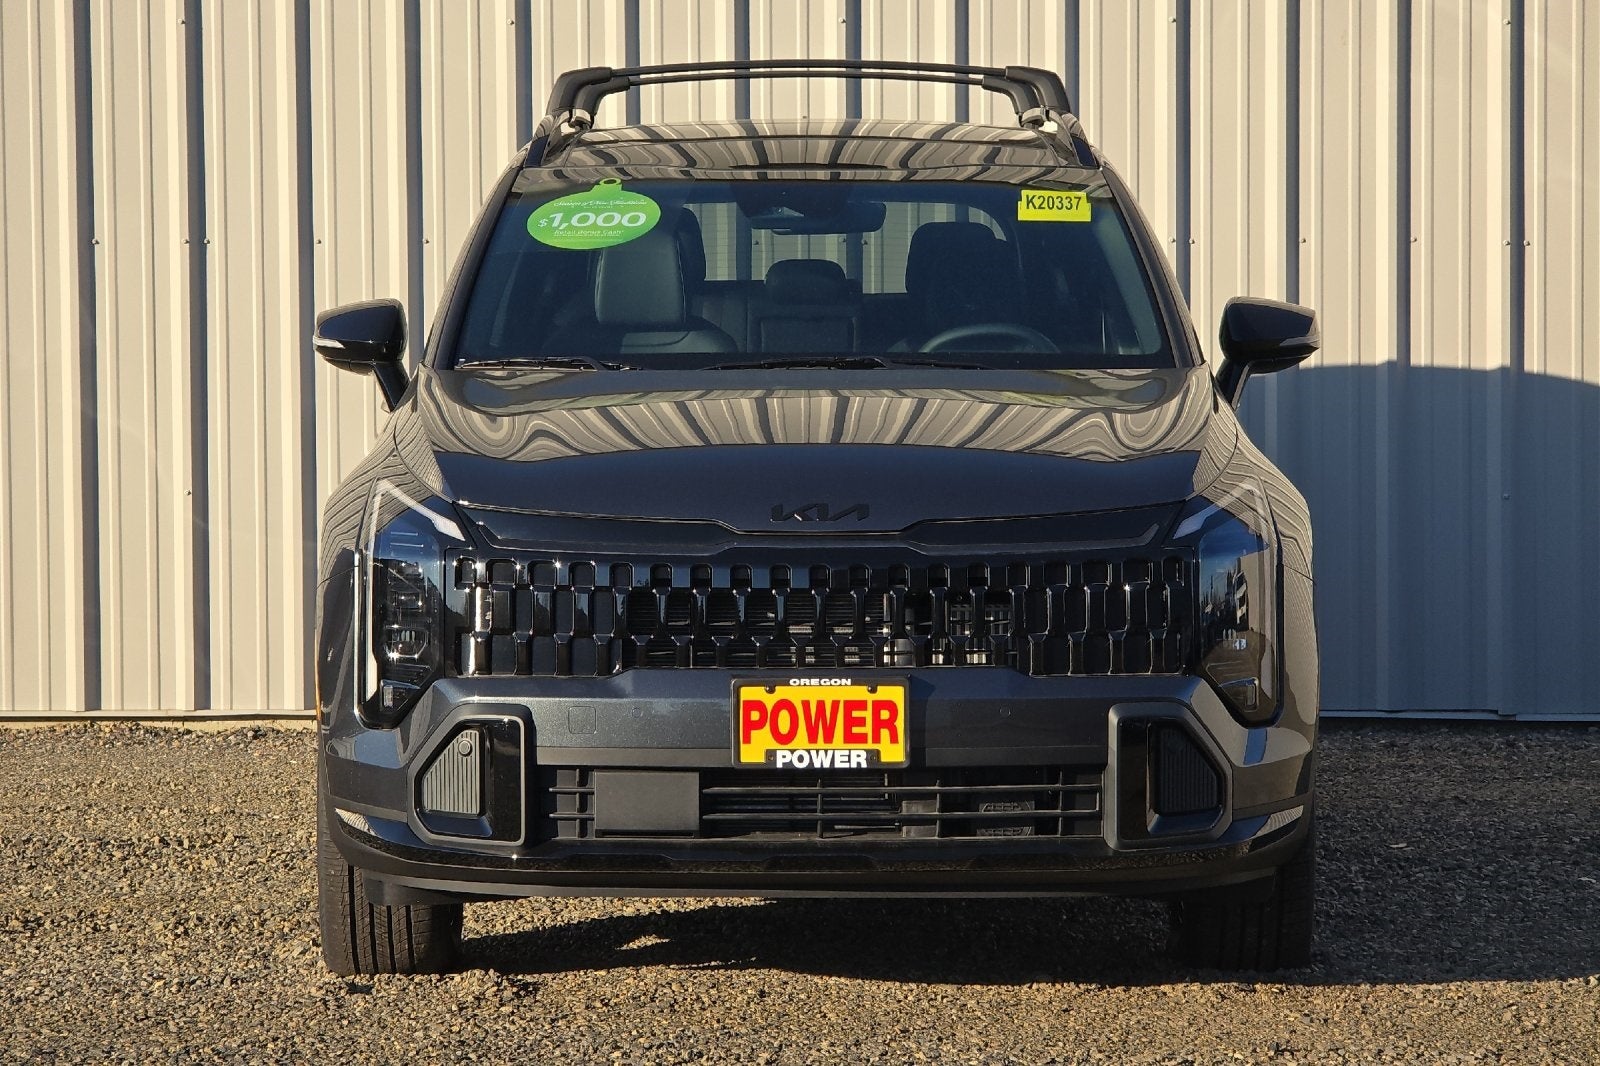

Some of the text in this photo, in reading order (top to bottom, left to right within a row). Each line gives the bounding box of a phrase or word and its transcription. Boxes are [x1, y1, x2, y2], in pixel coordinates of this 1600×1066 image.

[1026, 194, 1081, 210] K20337
[537, 212, 647, 230] $1,000
[771, 503, 870, 521] KIA
[789, 678, 852, 686] OREGON
[742, 699, 899, 745] POWER
[776, 750, 867, 768] POWER
